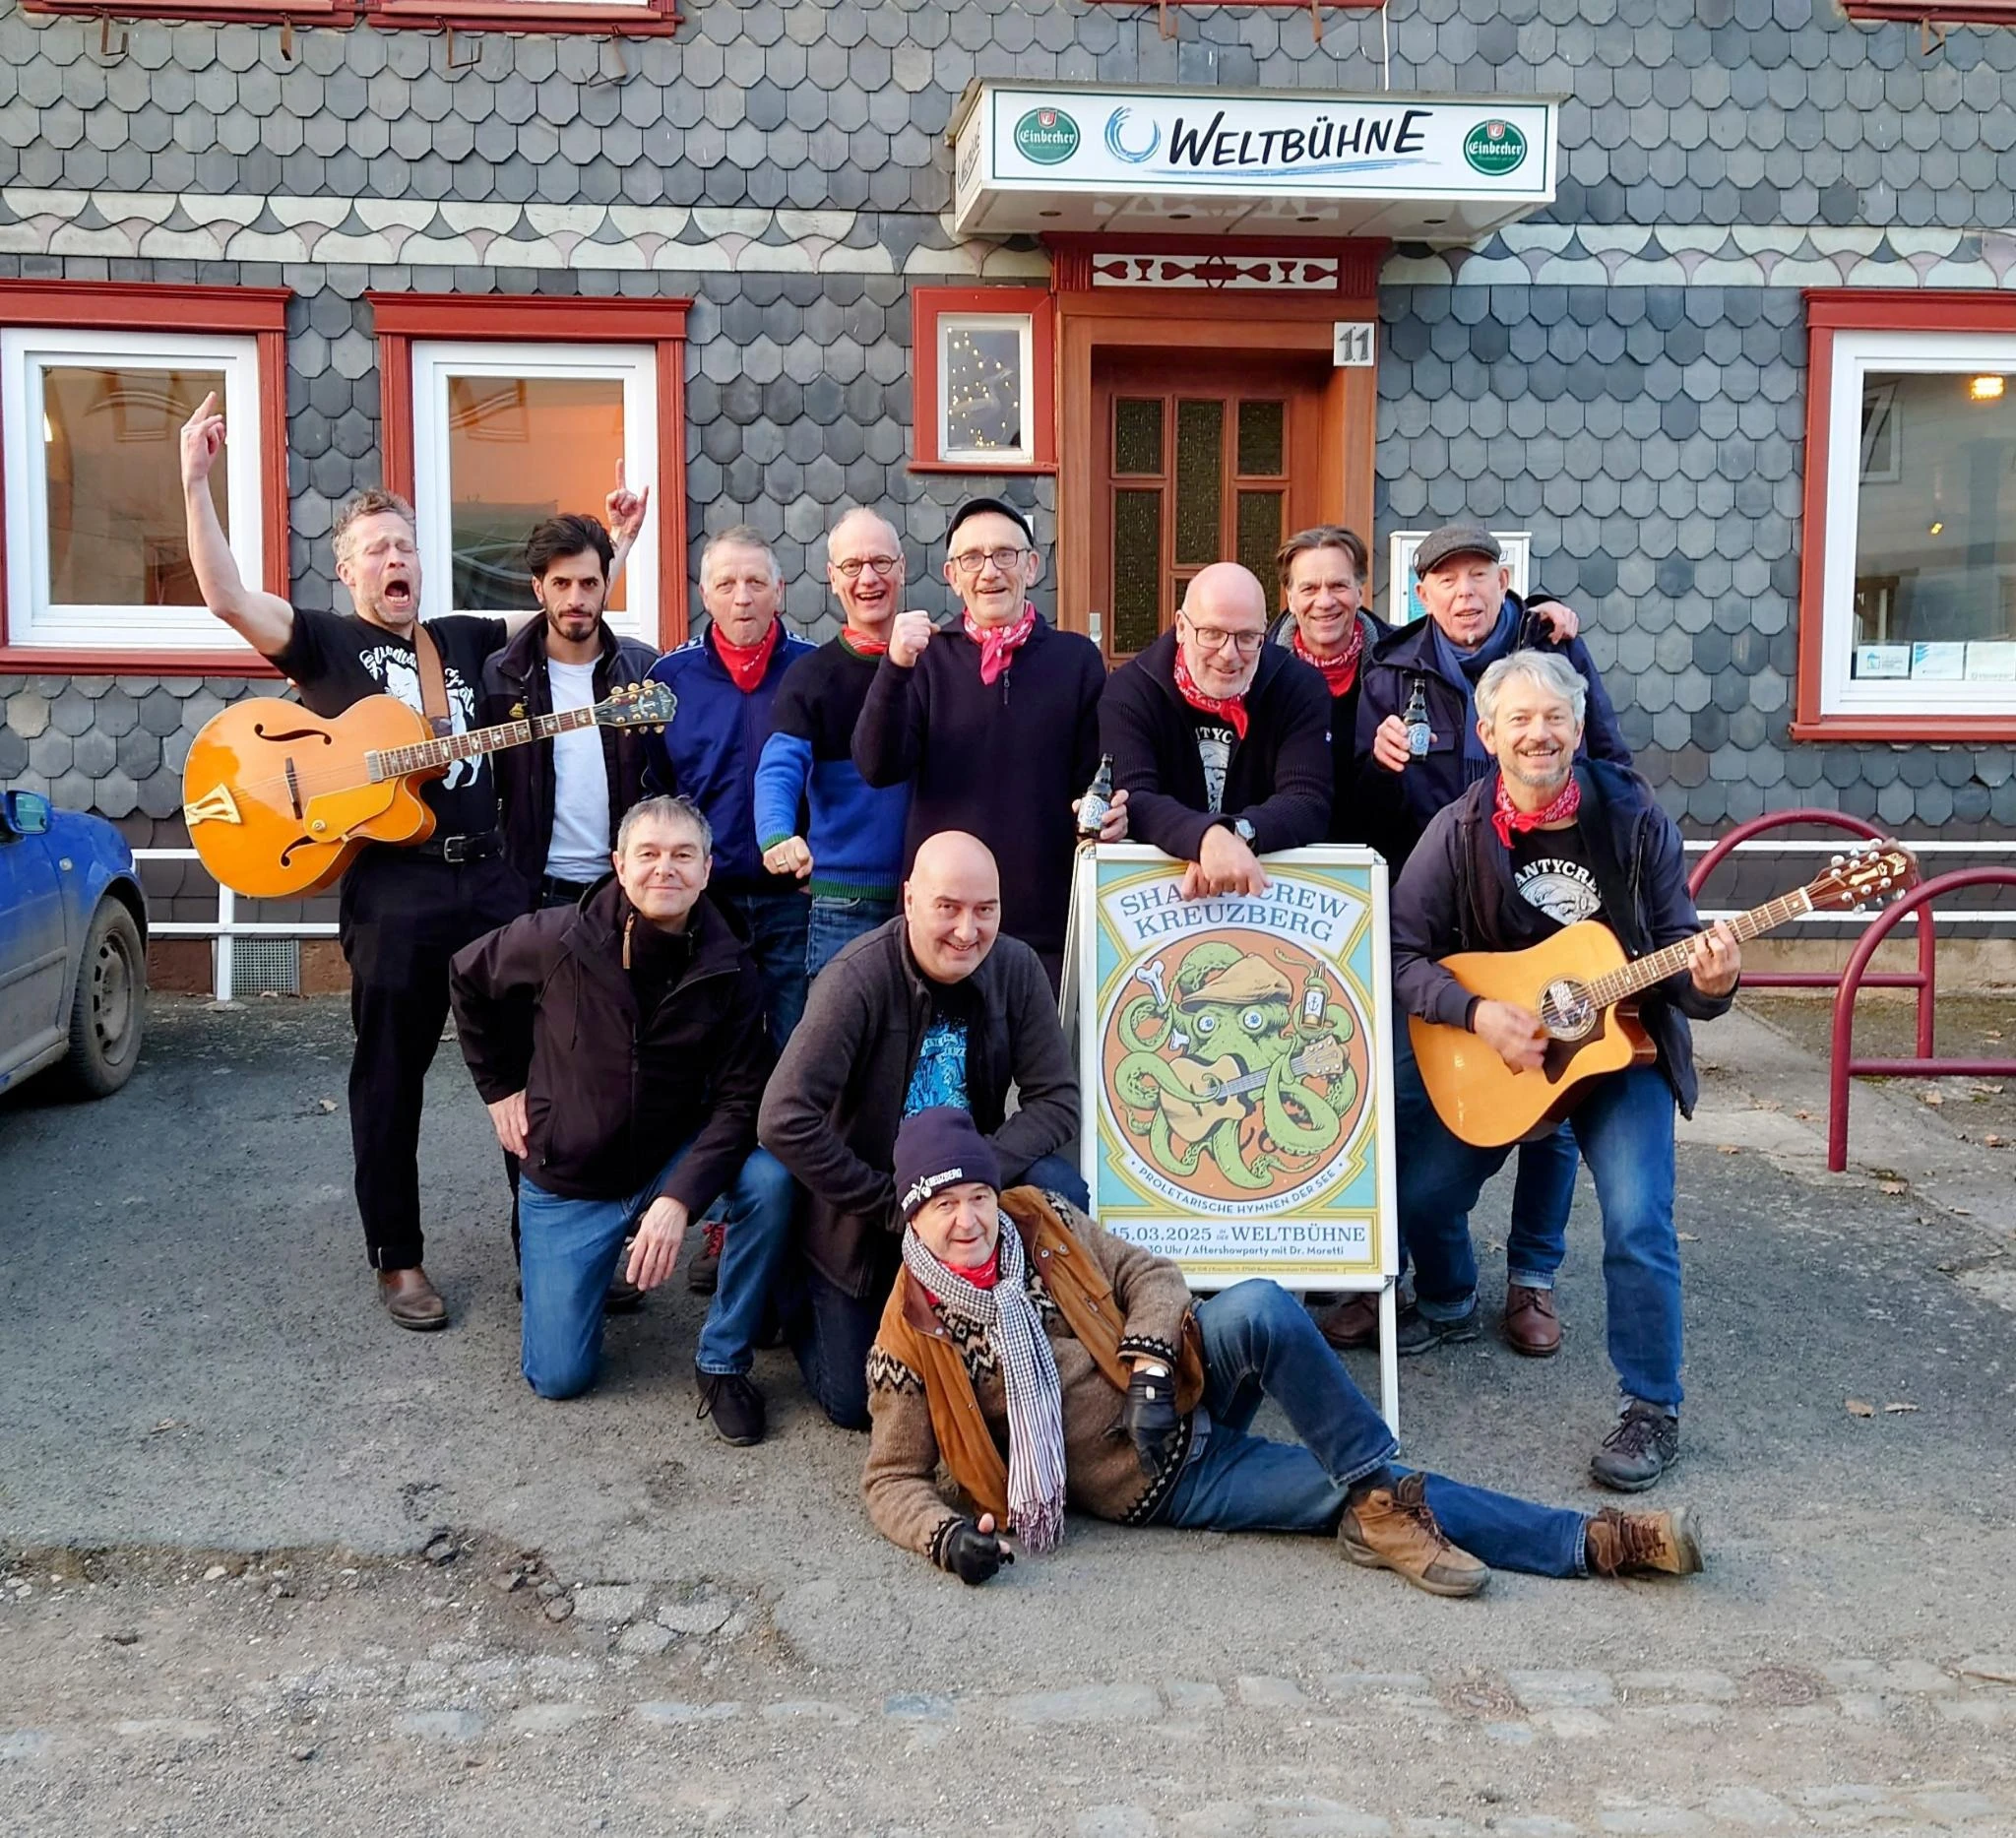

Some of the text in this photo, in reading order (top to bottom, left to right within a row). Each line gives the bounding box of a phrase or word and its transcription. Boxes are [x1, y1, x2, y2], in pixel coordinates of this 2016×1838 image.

[1169, 110, 1433, 166] WELTBÜHNE
[1339, 327, 1370, 362] 11
[1133, 903, 1334, 942] KREUZBERG
[1139, 1167, 1336, 1214] PROLETARISCHE HYMNEN DER SEE
[1231, 1222, 1366, 1241] WELTBÜHNE
[1165, 1244, 1182, 1254] Uhr
[1191, 1244, 1269, 1257] Aftershowparty
[1271, 1245, 1288, 1254] mit
[1290, 1245, 1305, 1255] Dr.
[1307, 1245, 1344, 1255] Moretti
